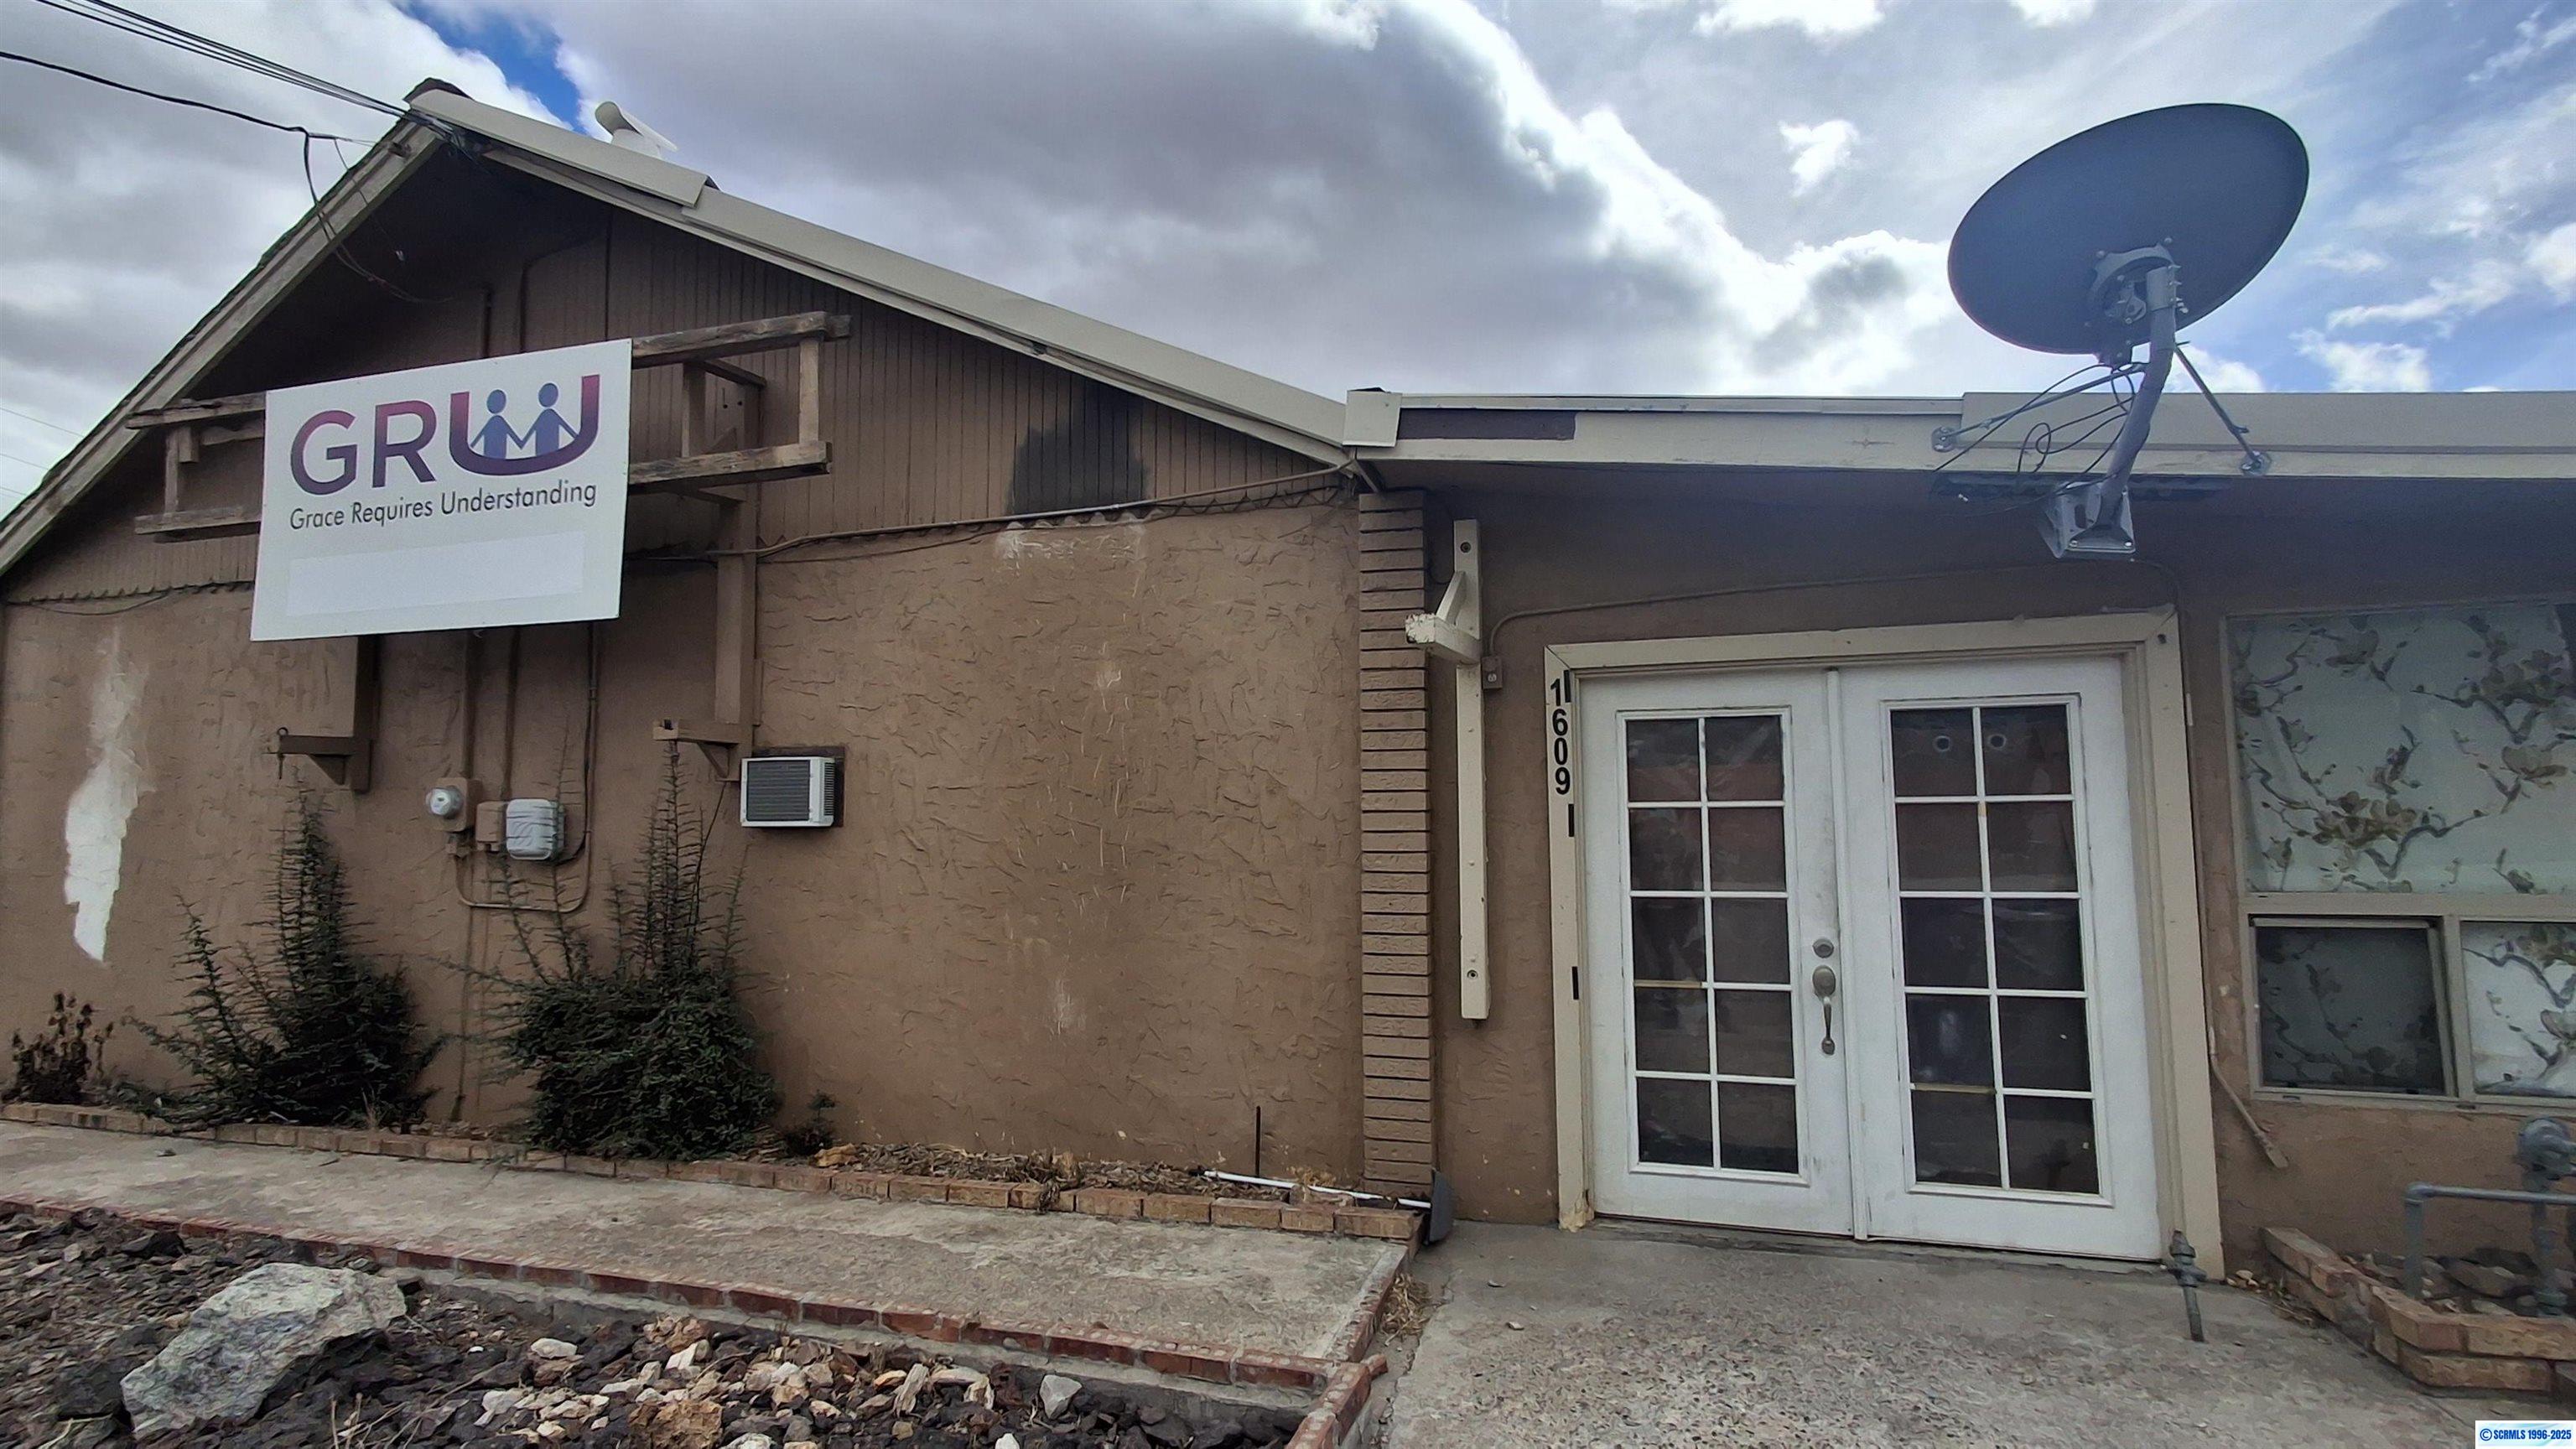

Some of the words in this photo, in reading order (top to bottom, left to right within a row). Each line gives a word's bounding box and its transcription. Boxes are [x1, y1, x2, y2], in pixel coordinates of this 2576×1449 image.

[290, 374, 600, 496] GRU
[290, 506, 345, 530] Grace
[351, 496, 434, 527] Requires
[440, 480, 597, 516] Understanding
[1550, 678, 1571, 795] 1609
